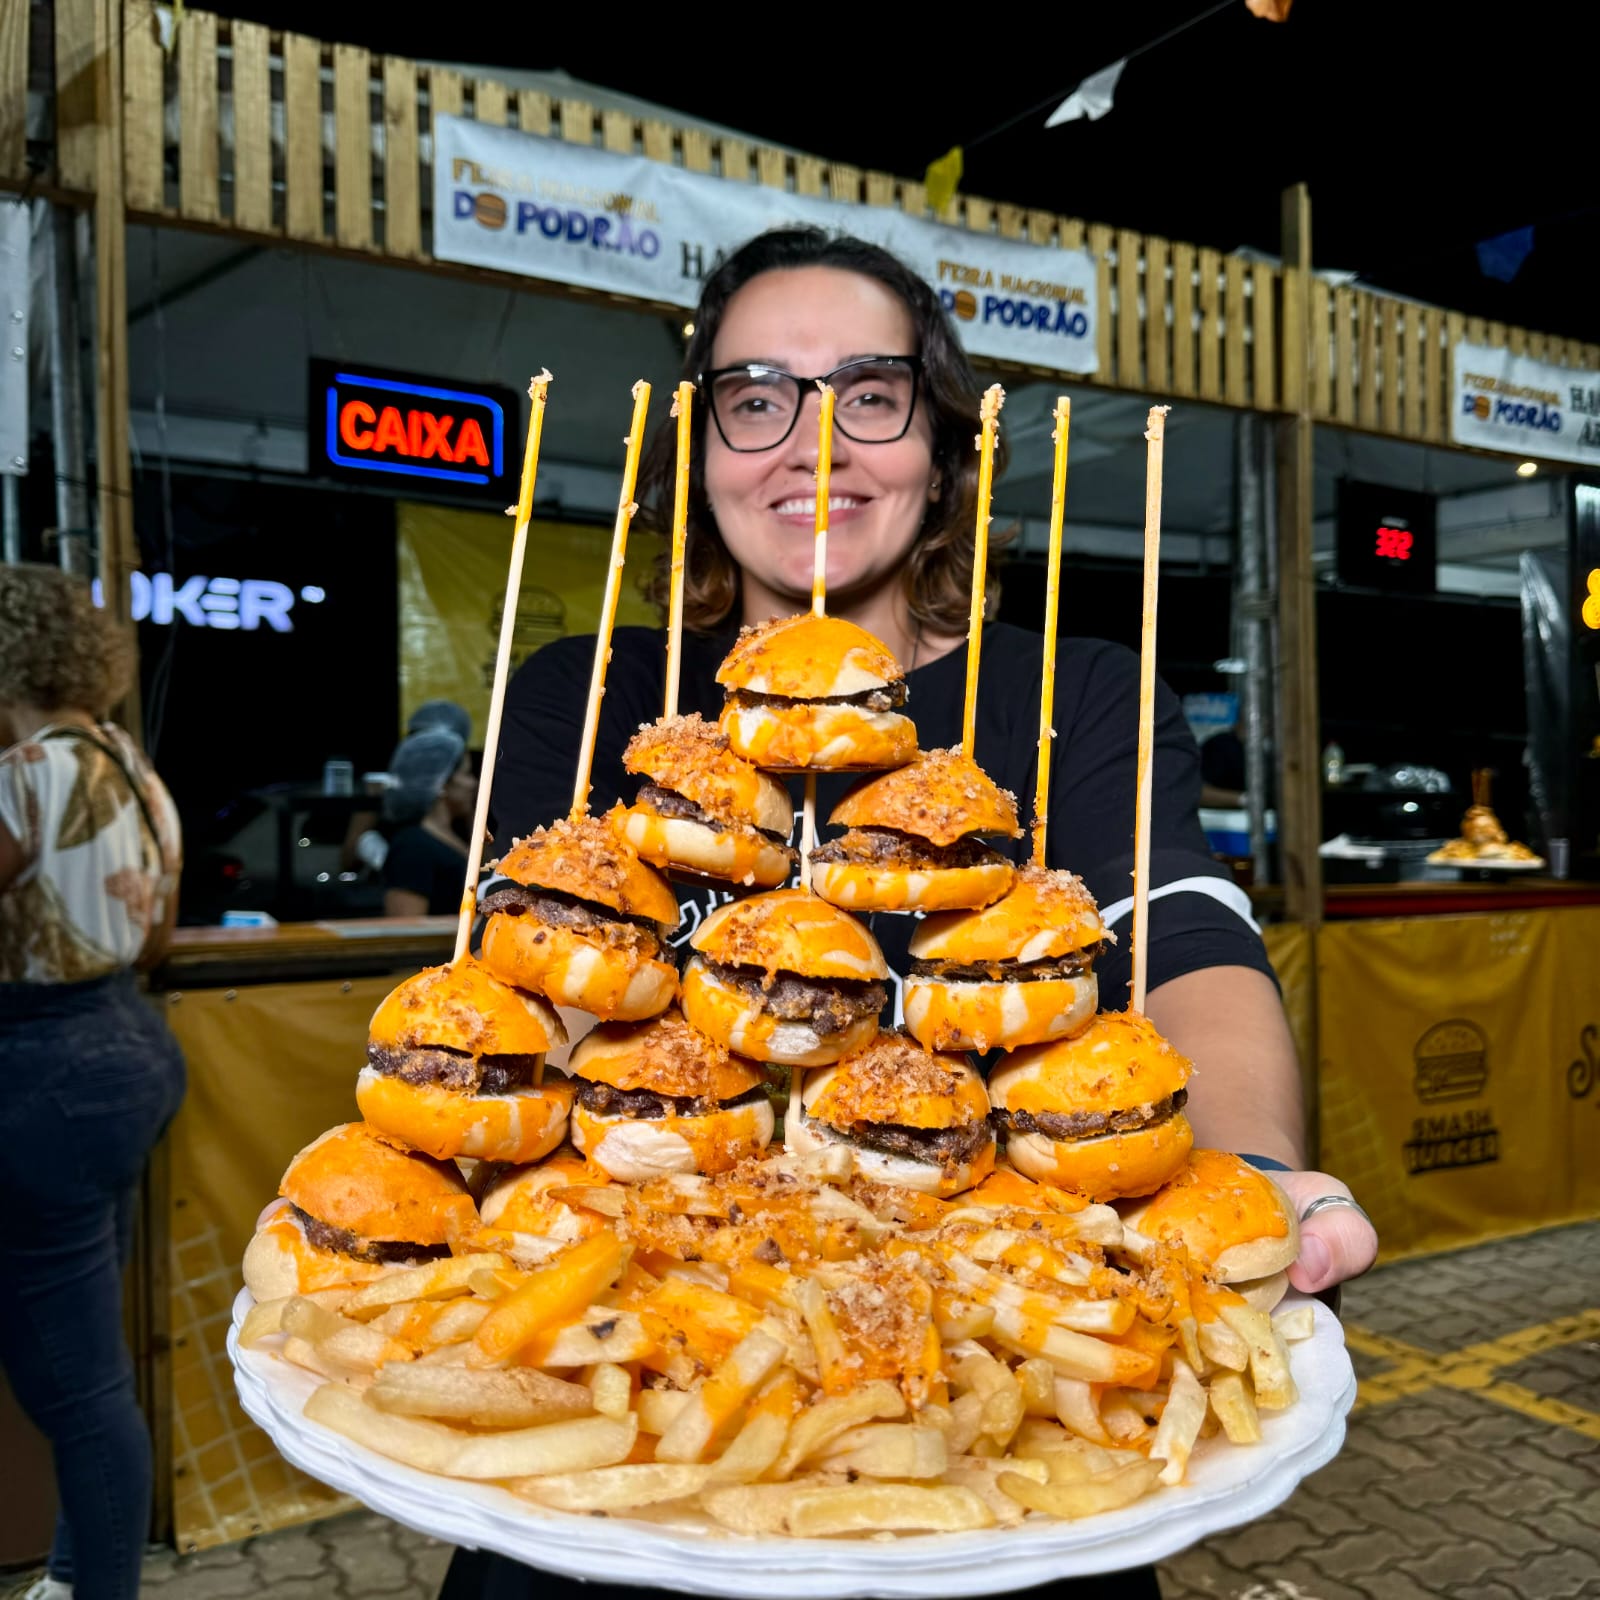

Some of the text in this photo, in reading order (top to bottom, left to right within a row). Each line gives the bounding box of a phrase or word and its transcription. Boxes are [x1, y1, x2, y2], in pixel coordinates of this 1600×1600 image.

[517, 200, 660, 260] PODRÃO
[938, 260, 1087, 305] FEIRA NACIONAL
[983, 295, 1088, 339] PODRÃO
[339, 400, 490, 466] CAIXA
[1412, 1109, 1492, 1139] SMASH
